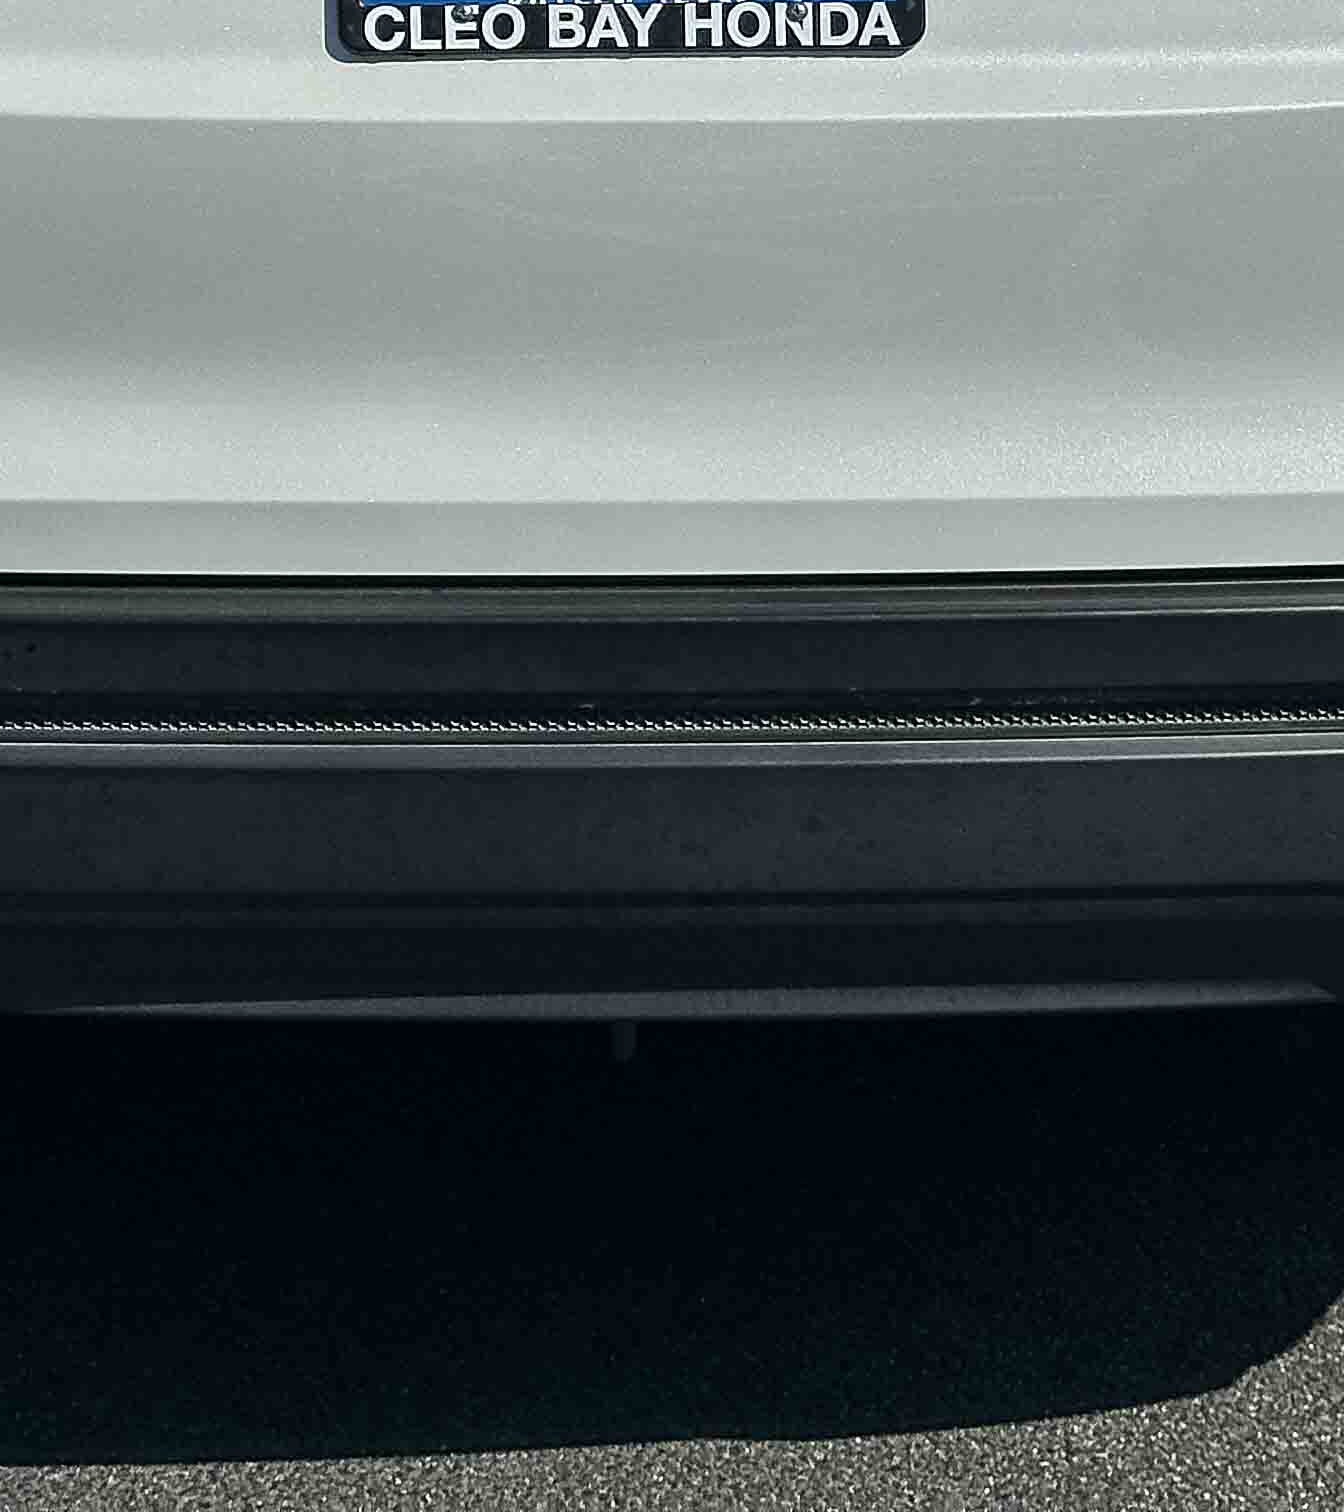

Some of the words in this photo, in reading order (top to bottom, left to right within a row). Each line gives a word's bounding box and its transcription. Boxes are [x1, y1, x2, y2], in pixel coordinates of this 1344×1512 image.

[364, 4, 526, 51] CLEO
[547, 3, 662, 49] BAY
[684, 1, 902, 48] HONDA
